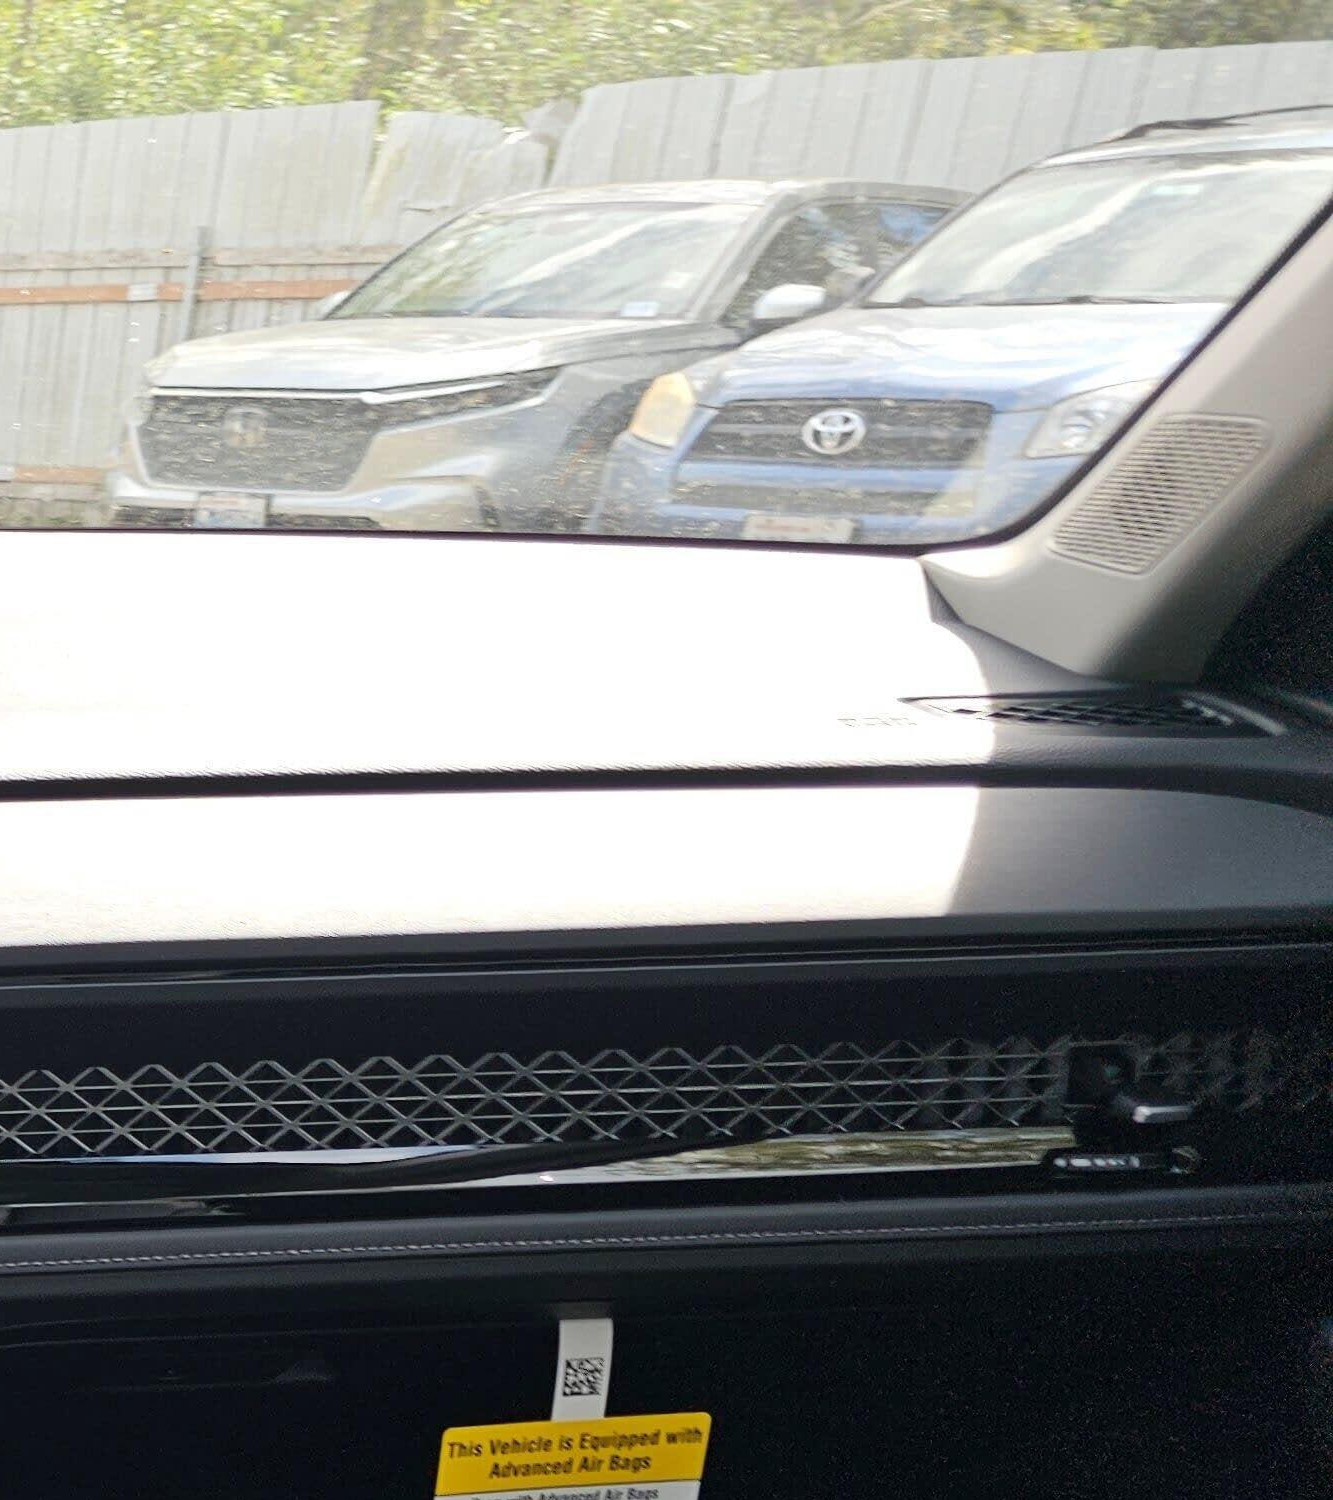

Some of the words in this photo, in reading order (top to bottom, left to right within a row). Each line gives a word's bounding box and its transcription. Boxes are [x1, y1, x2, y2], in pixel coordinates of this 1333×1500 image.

[447, 1442, 482, 1458] This
[490, 1437, 553, 1456] Vehicle
[559, 1435, 573, 1451] is
[579, 1429, 660, 1452] Equipped
[666, 1427, 703, 1444] with
[489, 1457, 573, 1479] Advanced
[580, 1455, 601, 1473] Air
[610, 1454, 651, 1473] Bags
[604, 1489, 622, 1500] Air
